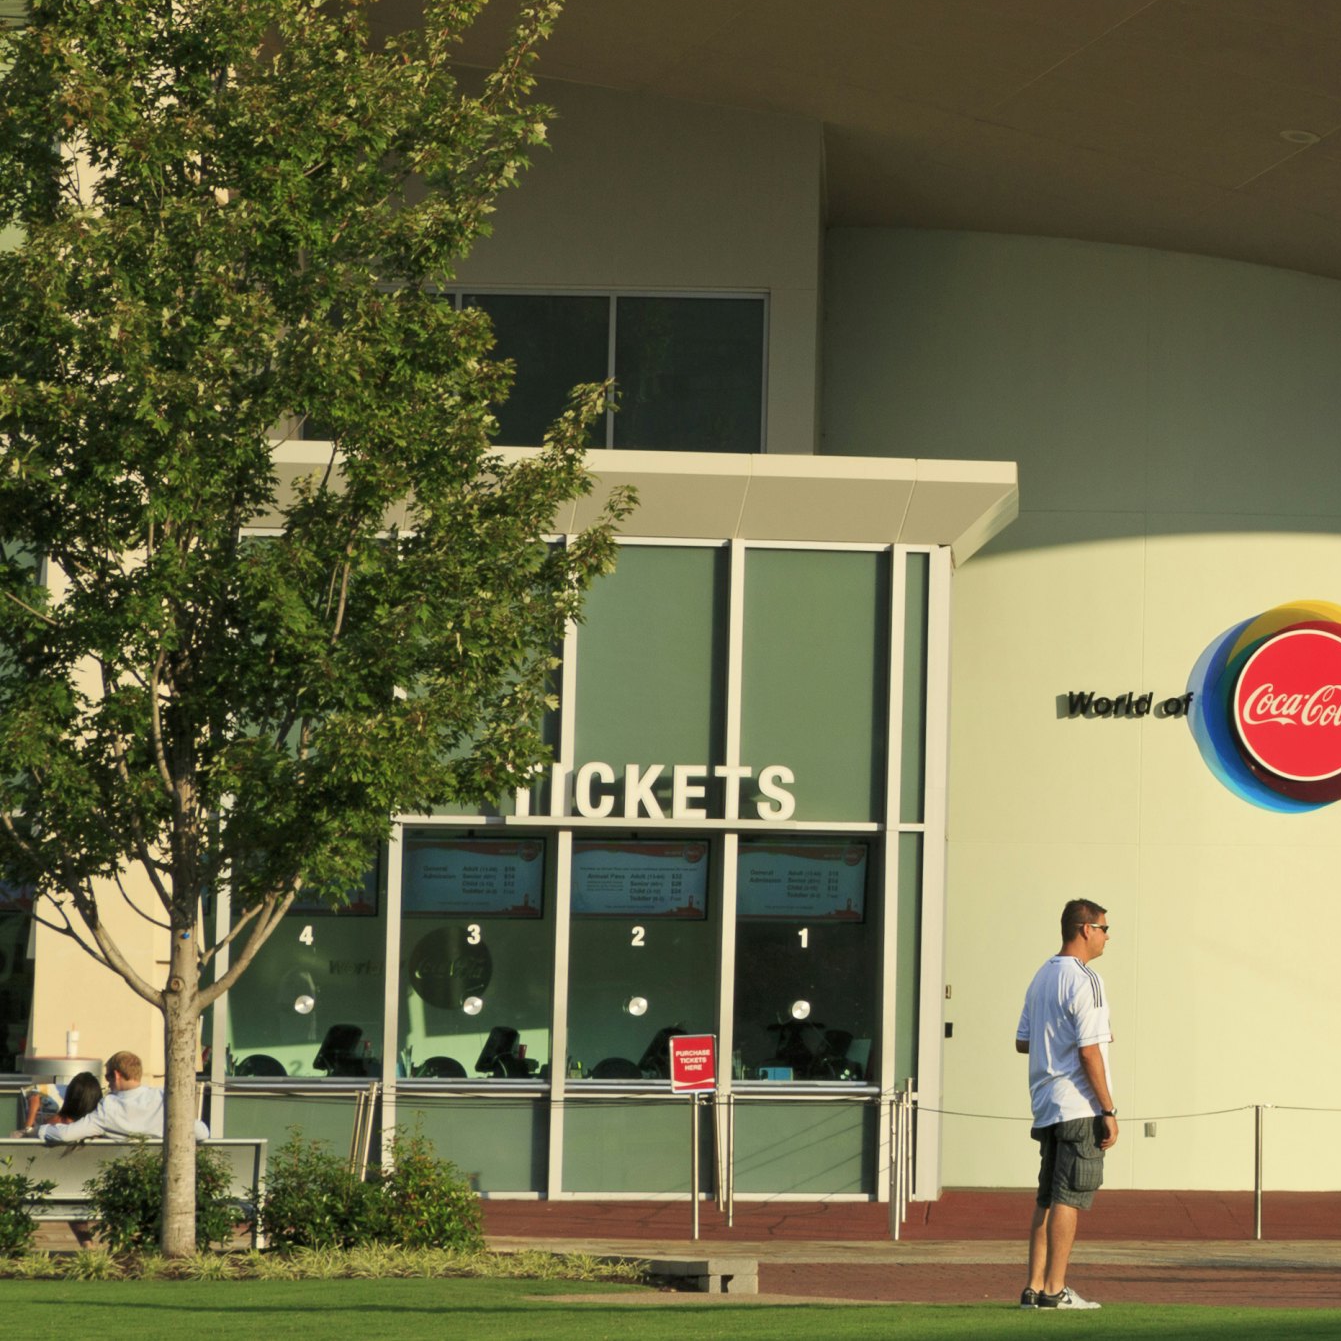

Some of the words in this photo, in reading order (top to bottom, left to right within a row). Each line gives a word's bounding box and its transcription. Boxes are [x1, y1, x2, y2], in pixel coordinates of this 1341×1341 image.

[1066, 690, 1154, 716] World
[1164, 691, 1195, 716] of
[299, 925, 314, 946] 4
[467, 924, 481, 945] 3
[631, 926, 645, 946] 2
[798, 927, 809, 948] 1
[675, 1049, 711, 1057] PURCHASE
[680, 1056, 708, 1064] TICKETS
[684, 1063, 703, 1071] HERE
